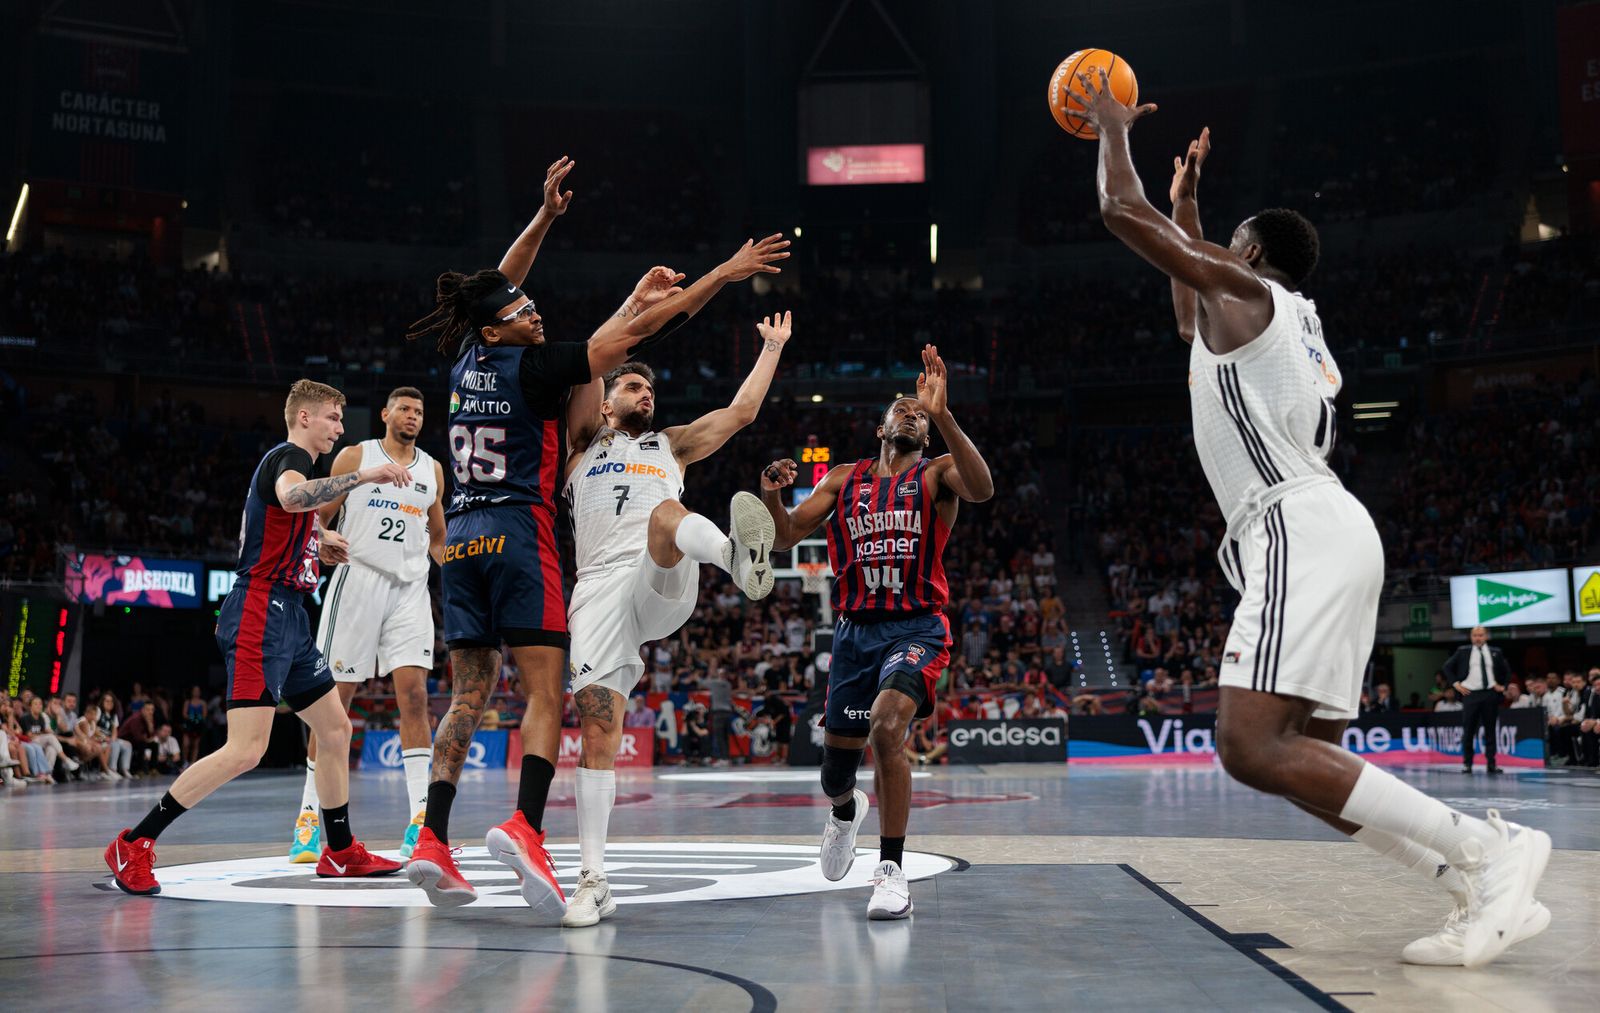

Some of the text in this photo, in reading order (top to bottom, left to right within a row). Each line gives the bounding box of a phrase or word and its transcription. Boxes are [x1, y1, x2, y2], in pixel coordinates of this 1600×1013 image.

[60, 89, 160, 120] CARÁCTER
[51, 112, 167, 144] NORTASUNA
[462, 399, 511, 415] AMUTIO
[448, 424, 507, 485] 95
[585, 462, 667, 479] AUTOHERO
[612, 484, 631, 517] 7
[378, 517, 406, 542] 22
[845, 510, 922, 540] BASKONIA
[122, 568, 197, 598] BASKONIA
[861, 565, 904, 595] 44
[950, 722, 1062, 748] endesa
[1137, 719, 1214, 755] Via
